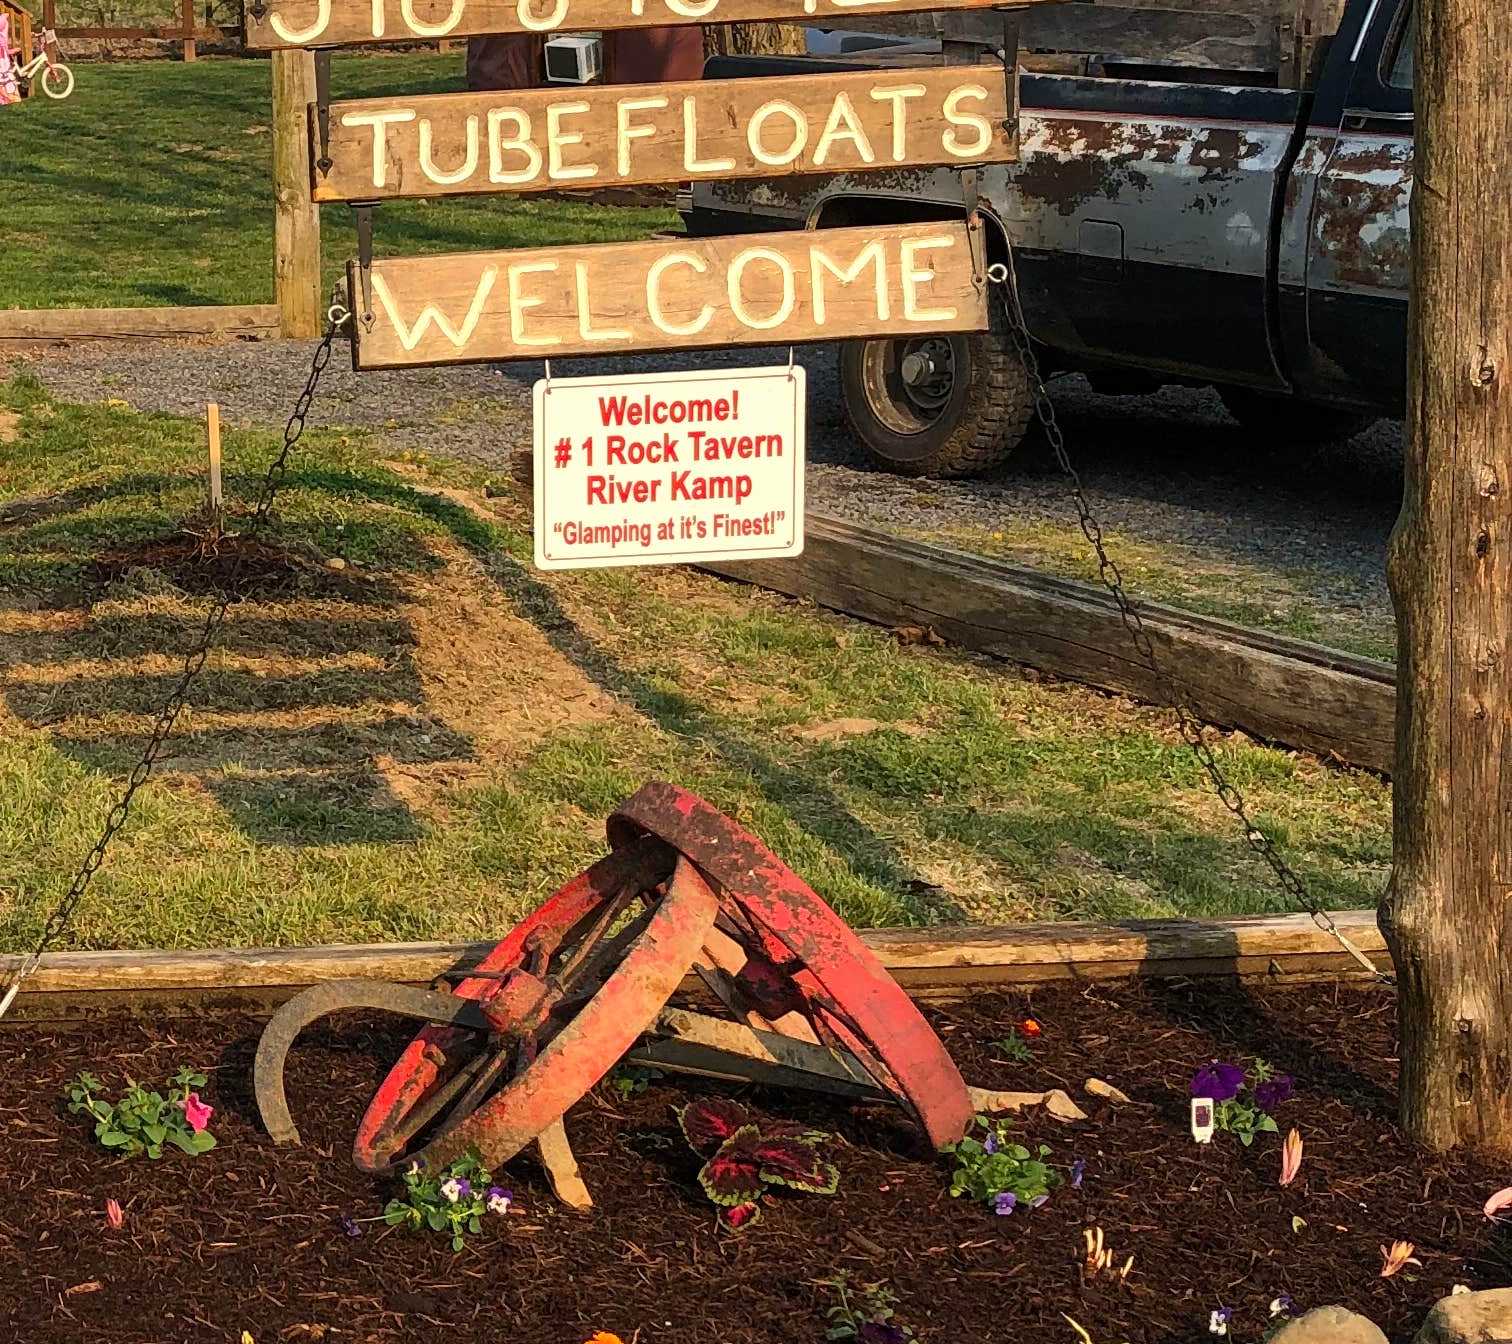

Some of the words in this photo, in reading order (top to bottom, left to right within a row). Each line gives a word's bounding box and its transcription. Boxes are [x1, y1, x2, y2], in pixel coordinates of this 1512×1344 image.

[370, 234, 959, 351] WELCOME
[598, 390, 739, 427] Welcome!
[606, 433, 679, 465] Rock
[688, 431, 783, 461] Tavern
[586, 474, 661, 505] River
[671, 470, 753, 505] Kamp
[657, 520, 674, 540] at
[680, 517, 707, 539] it’s
